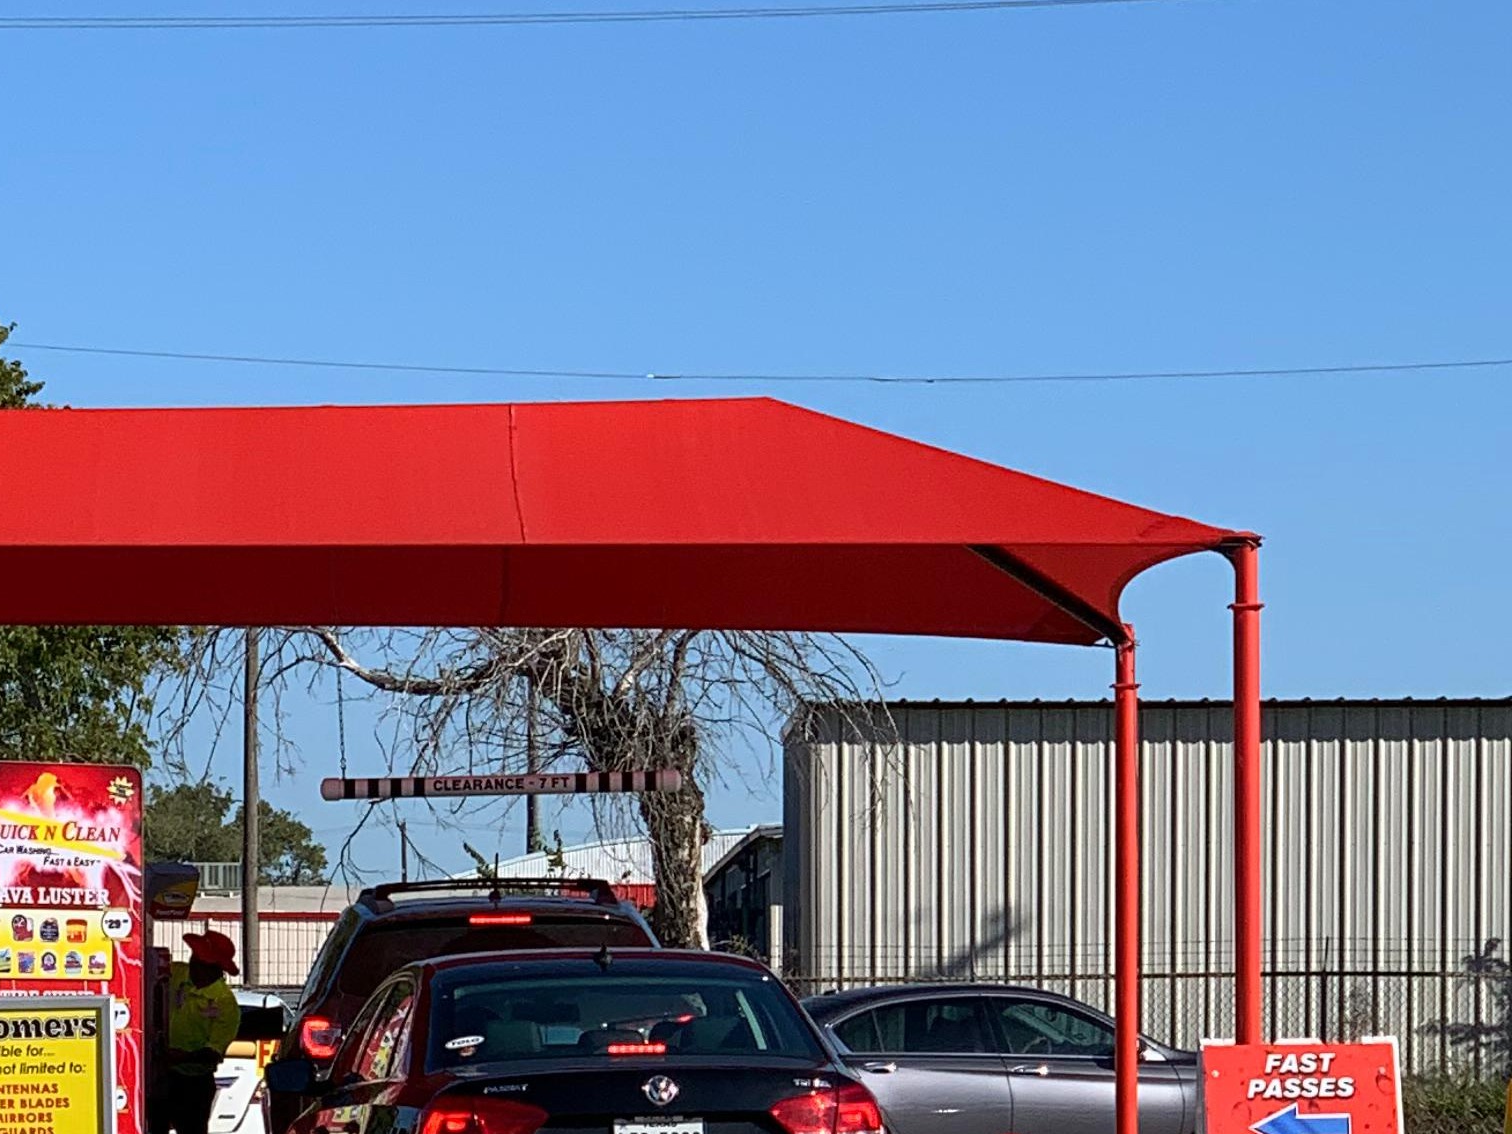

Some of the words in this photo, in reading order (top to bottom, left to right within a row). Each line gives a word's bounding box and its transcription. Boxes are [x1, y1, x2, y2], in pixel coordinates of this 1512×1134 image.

[433, 777, 524, 792] CLEARANCE
[539, 777, 547, 789] 7
[551, 776, 570, 789] FT
[43, 825, 57, 841] N
[61, 820, 121, 842] CLEAN
[43, 856, 65, 866] FAST
[37, 886, 111, 905] LUSTER
[19, 1062, 66, 1075] limited
[1265, 1052, 1336, 1075] FAST
[1246, 1078, 1355, 1099] PASSES
[20, 1097, 70, 1108] BLADES
